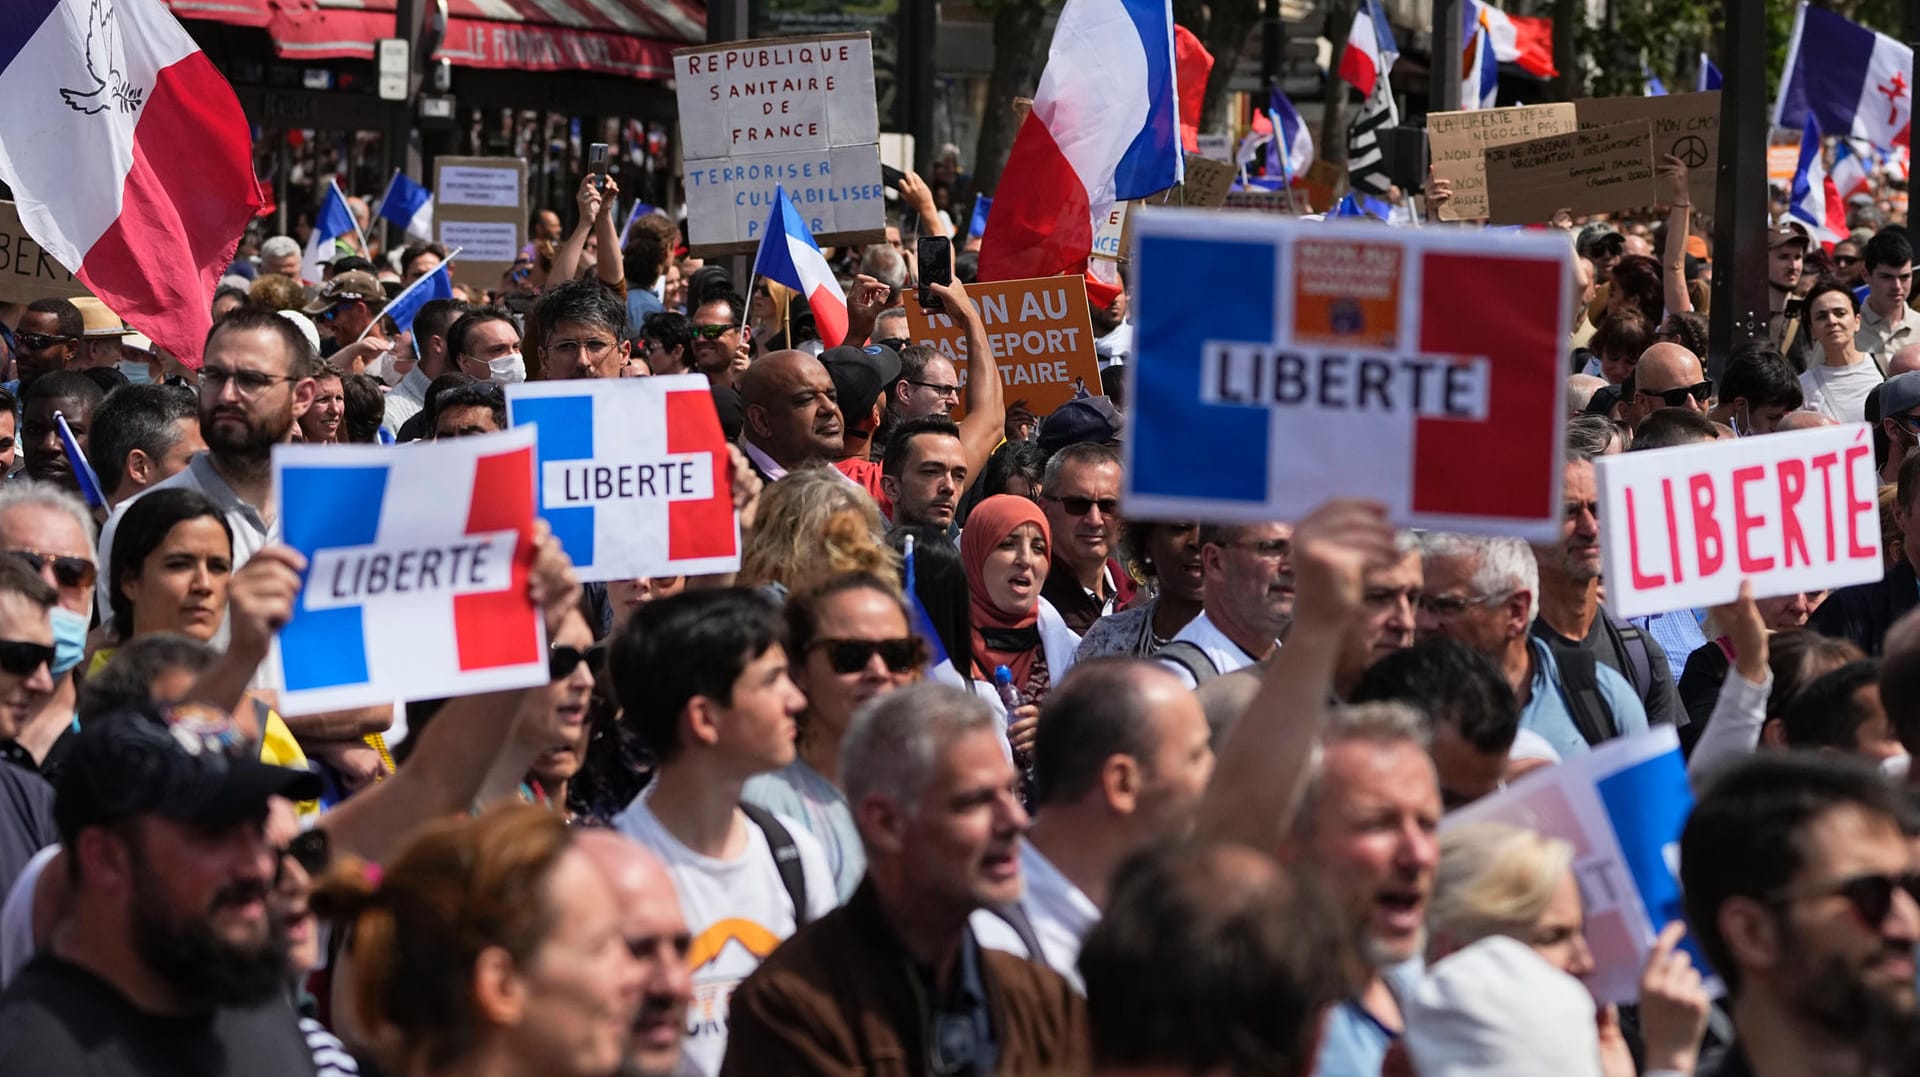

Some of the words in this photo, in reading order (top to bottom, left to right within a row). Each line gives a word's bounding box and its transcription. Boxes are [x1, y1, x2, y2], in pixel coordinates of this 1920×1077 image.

[688, 46, 849, 75] REPUBLIQUE
[709, 75, 836, 101] SANITAIRE
[762, 100, 790, 116] DE
[731, 122, 818, 145] FRANCE
[1473, 124, 1531, 141] NEGOCIE
[689, 160, 831, 187] TERRORISER
[735, 183, 883, 206] CULABILISER
[1019, 288, 1068, 322] AU
[1624, 427, 1877, 591] LIBERTÉ
